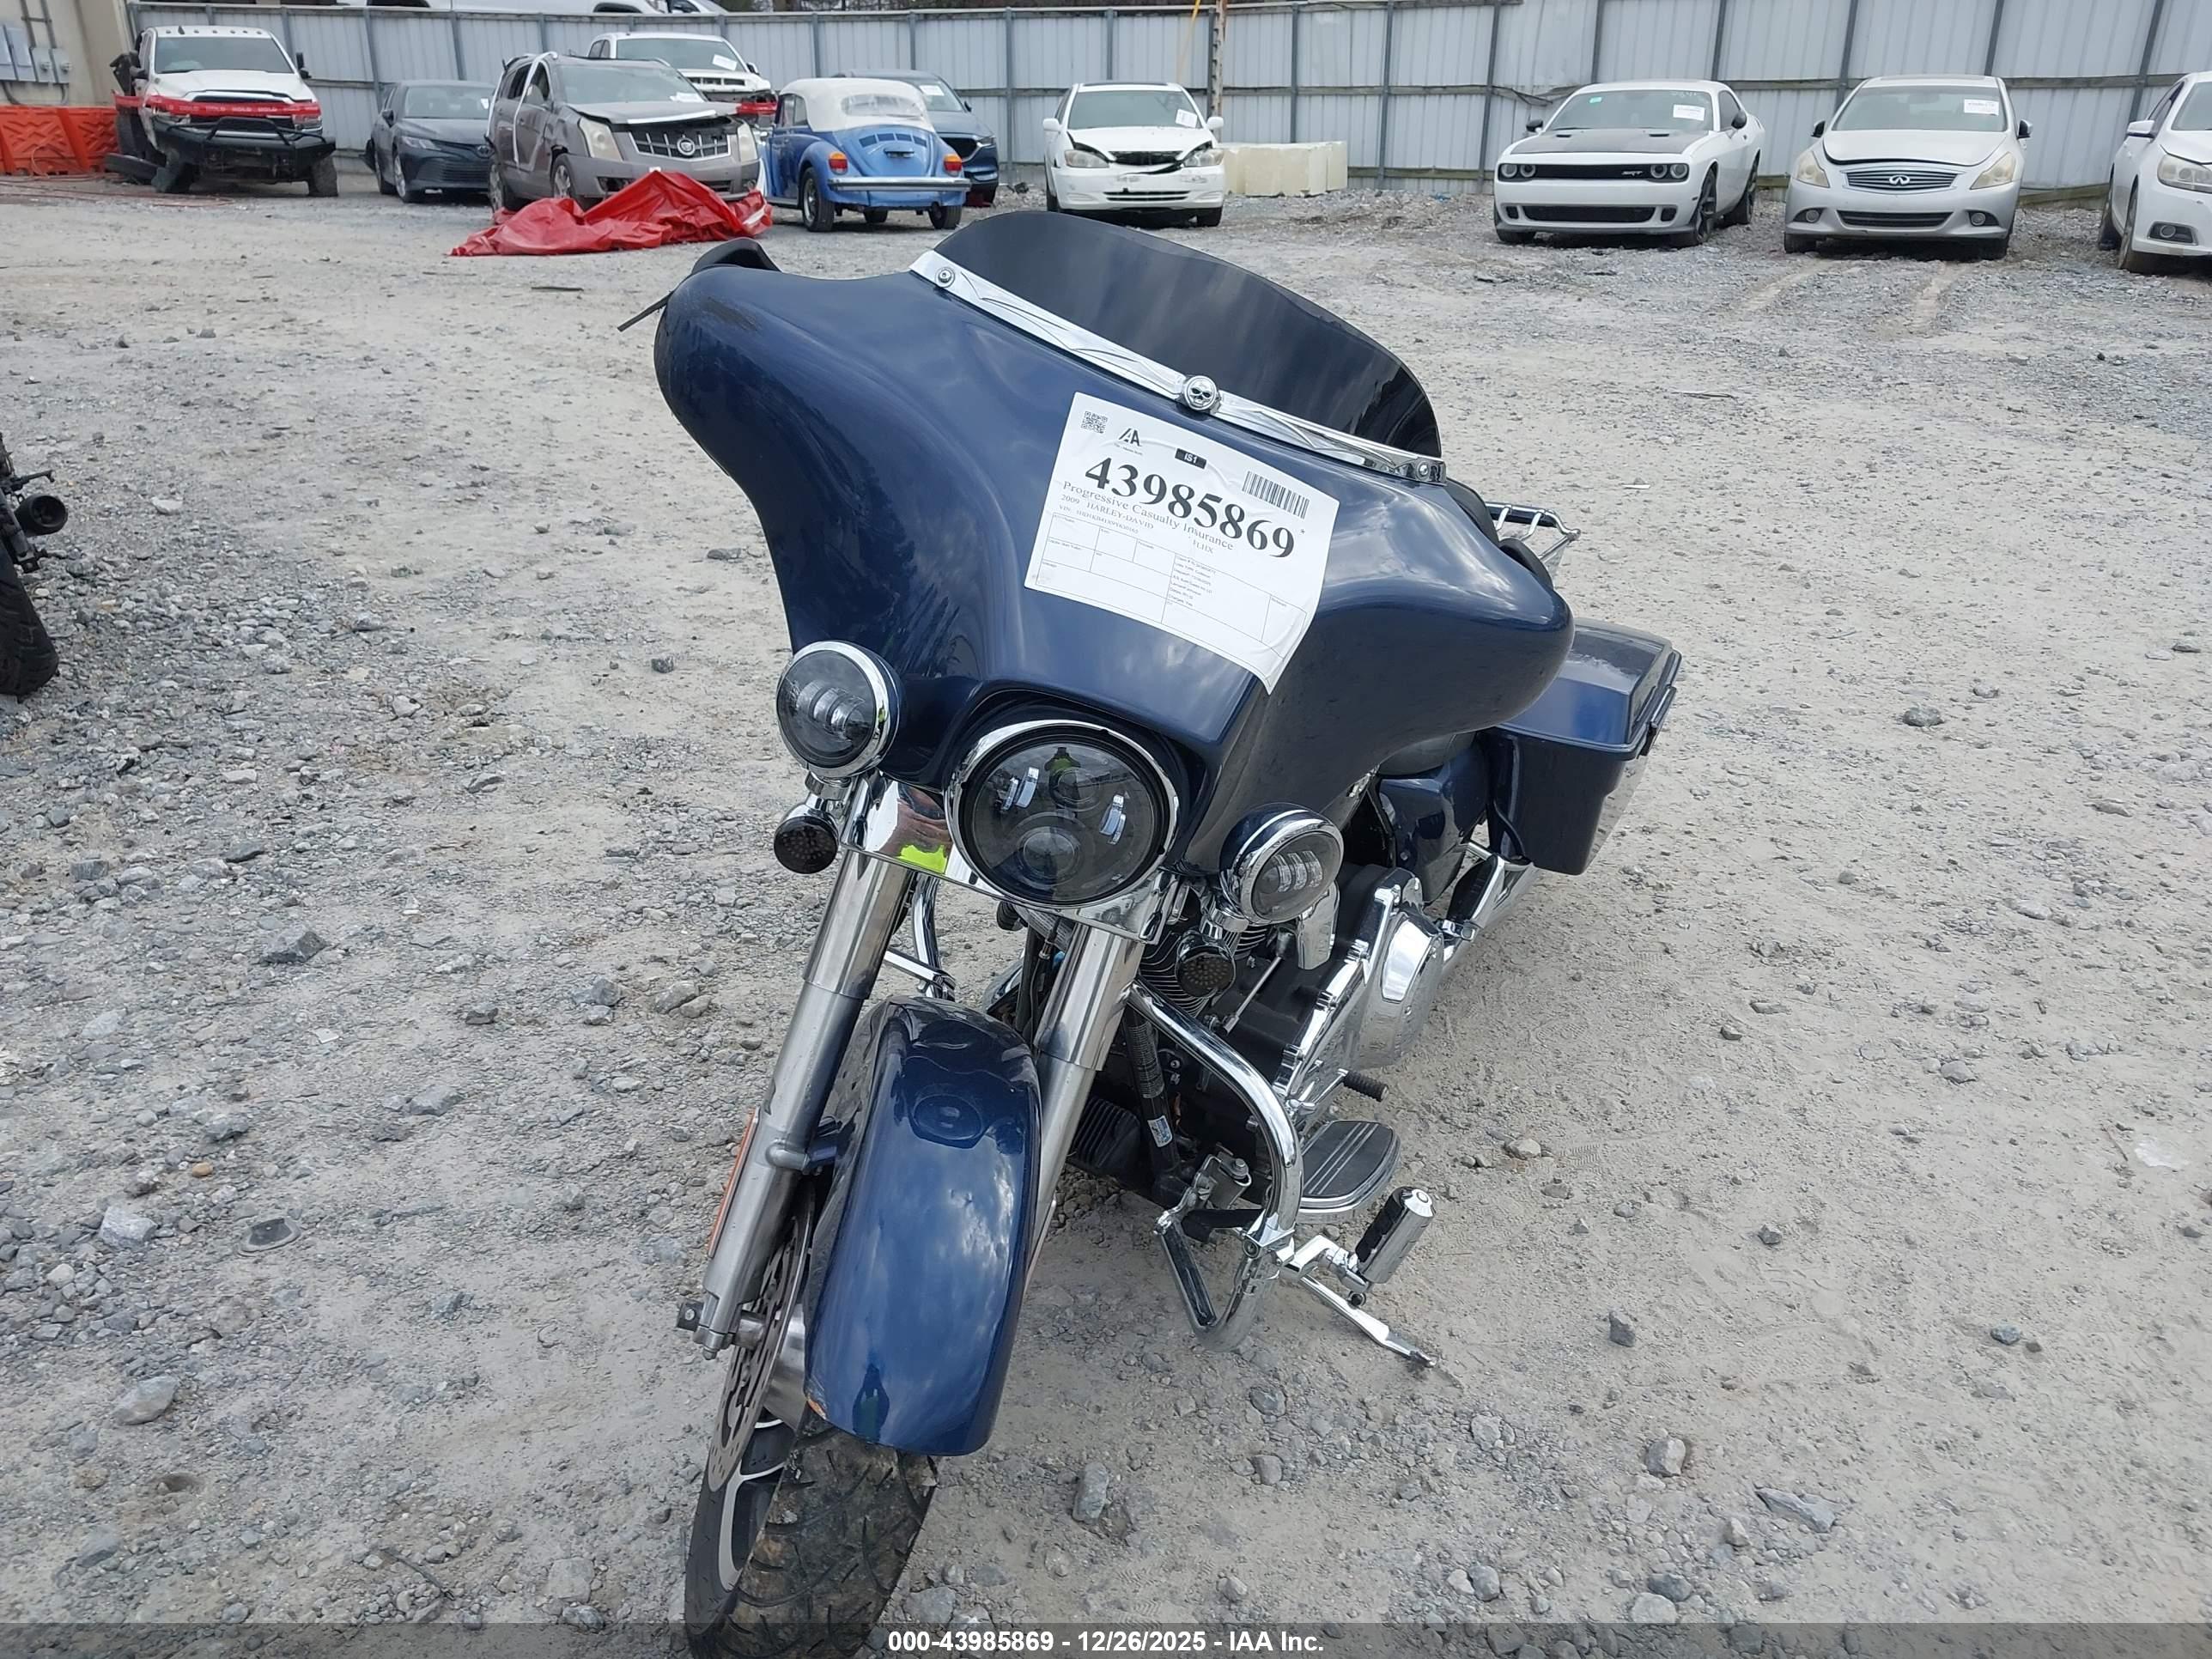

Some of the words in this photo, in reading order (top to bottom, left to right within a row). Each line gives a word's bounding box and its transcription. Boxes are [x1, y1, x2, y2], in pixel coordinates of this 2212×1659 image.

[1184, 453, 1198, 464] IS1
[1060, 494, 1080, 505] 2009
[1086, 502, 1154, 530] HARLEY-DAVID
[1062, 481, 1129, 510] Progressive
[1132, 504, 1180, 530] Casualty
[1183, 522, 1234, 550] Insurance
[1085, 457, 1294, 558] 43985869
